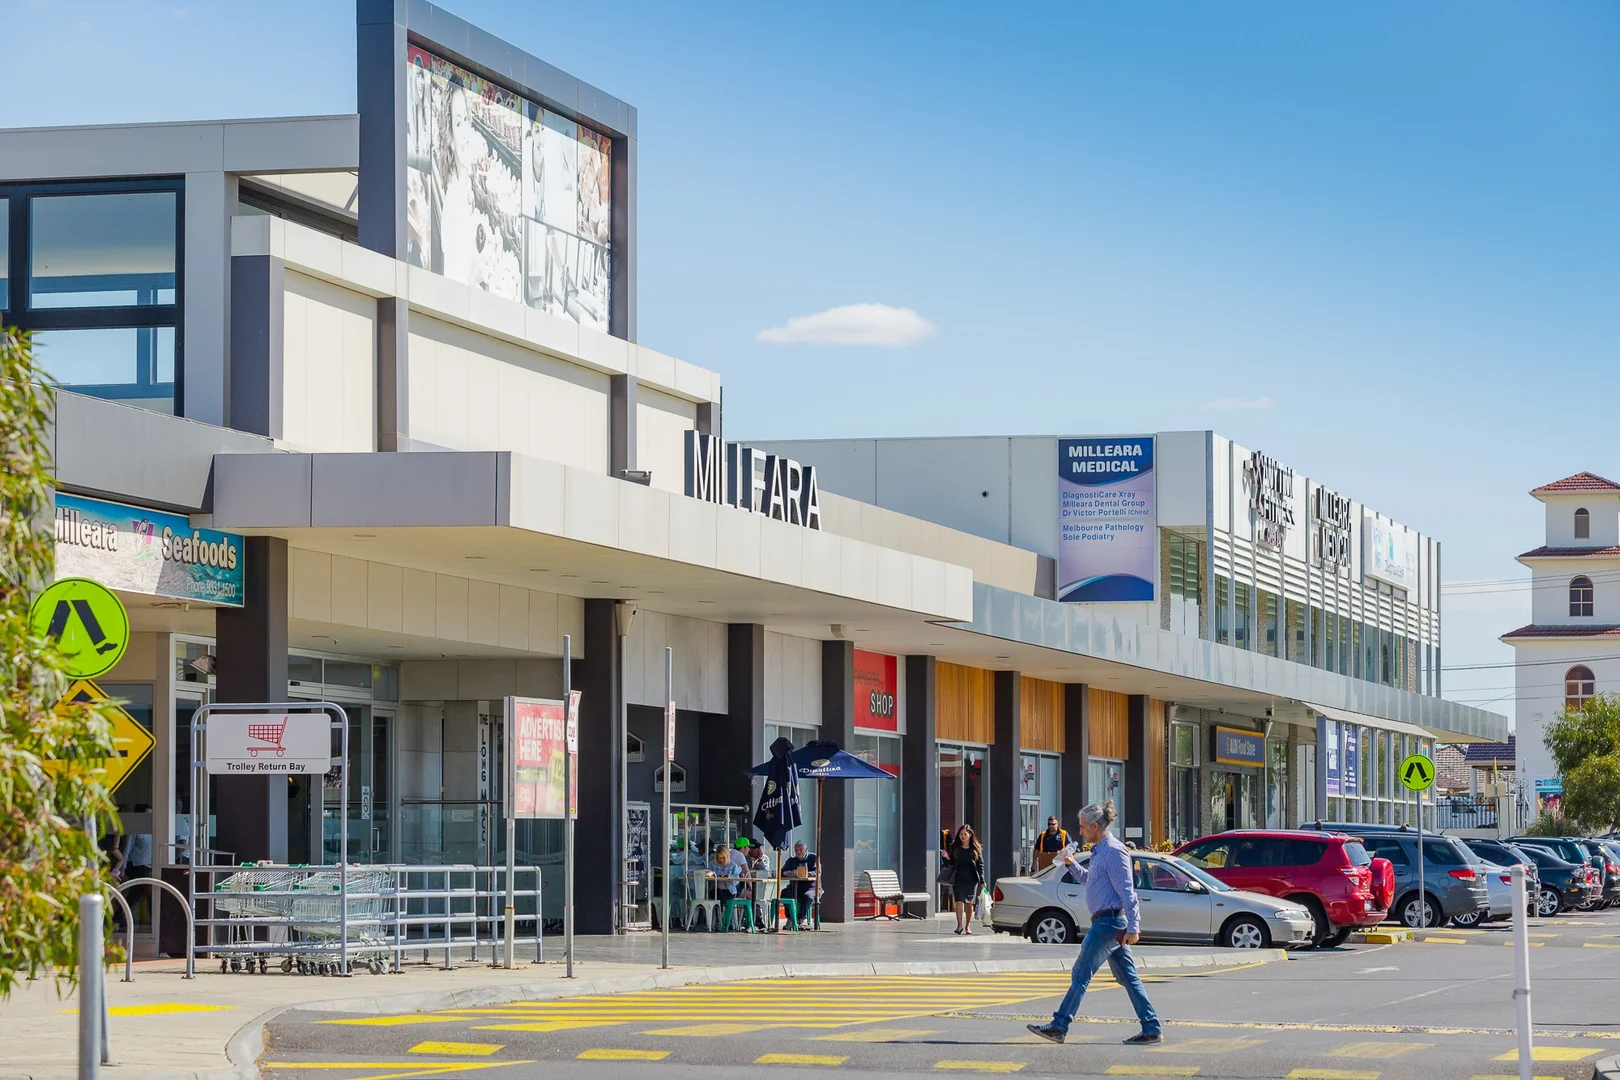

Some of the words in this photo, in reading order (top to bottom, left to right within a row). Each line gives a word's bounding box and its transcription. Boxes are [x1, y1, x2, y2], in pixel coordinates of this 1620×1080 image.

[1068, 444, 1142, 457] MILLEARA
[1072, 460, 1139, 473] MEDICAL
[684, 430, 822, 531] MILLEARA
[1062, 491, 1117, 500] DiagnostiCare
[1118, 491, 1136, 499] Xray
[1062, 500, 1093, 508] Milleara
[1121, 500, 1146, 508] Group
[1062, 524, 1103, 532] Melbourne
[1104, 524, 1144, 532] Pathology
[1062, 533, 1080, 541] Sole
[1081, 533, 1115, 541] Podiatry
[162, 525, 237, 571] Seafoods
[870, 691, 894, 717] SHOP
[520, 716, 565, 741] ADVERTIS
[519, 738, 542, 762] HERE
[226, 762, 256, 772] Trolley
[258, 762, 287, 770] Return
[289, 762, 306, 772] Bay
